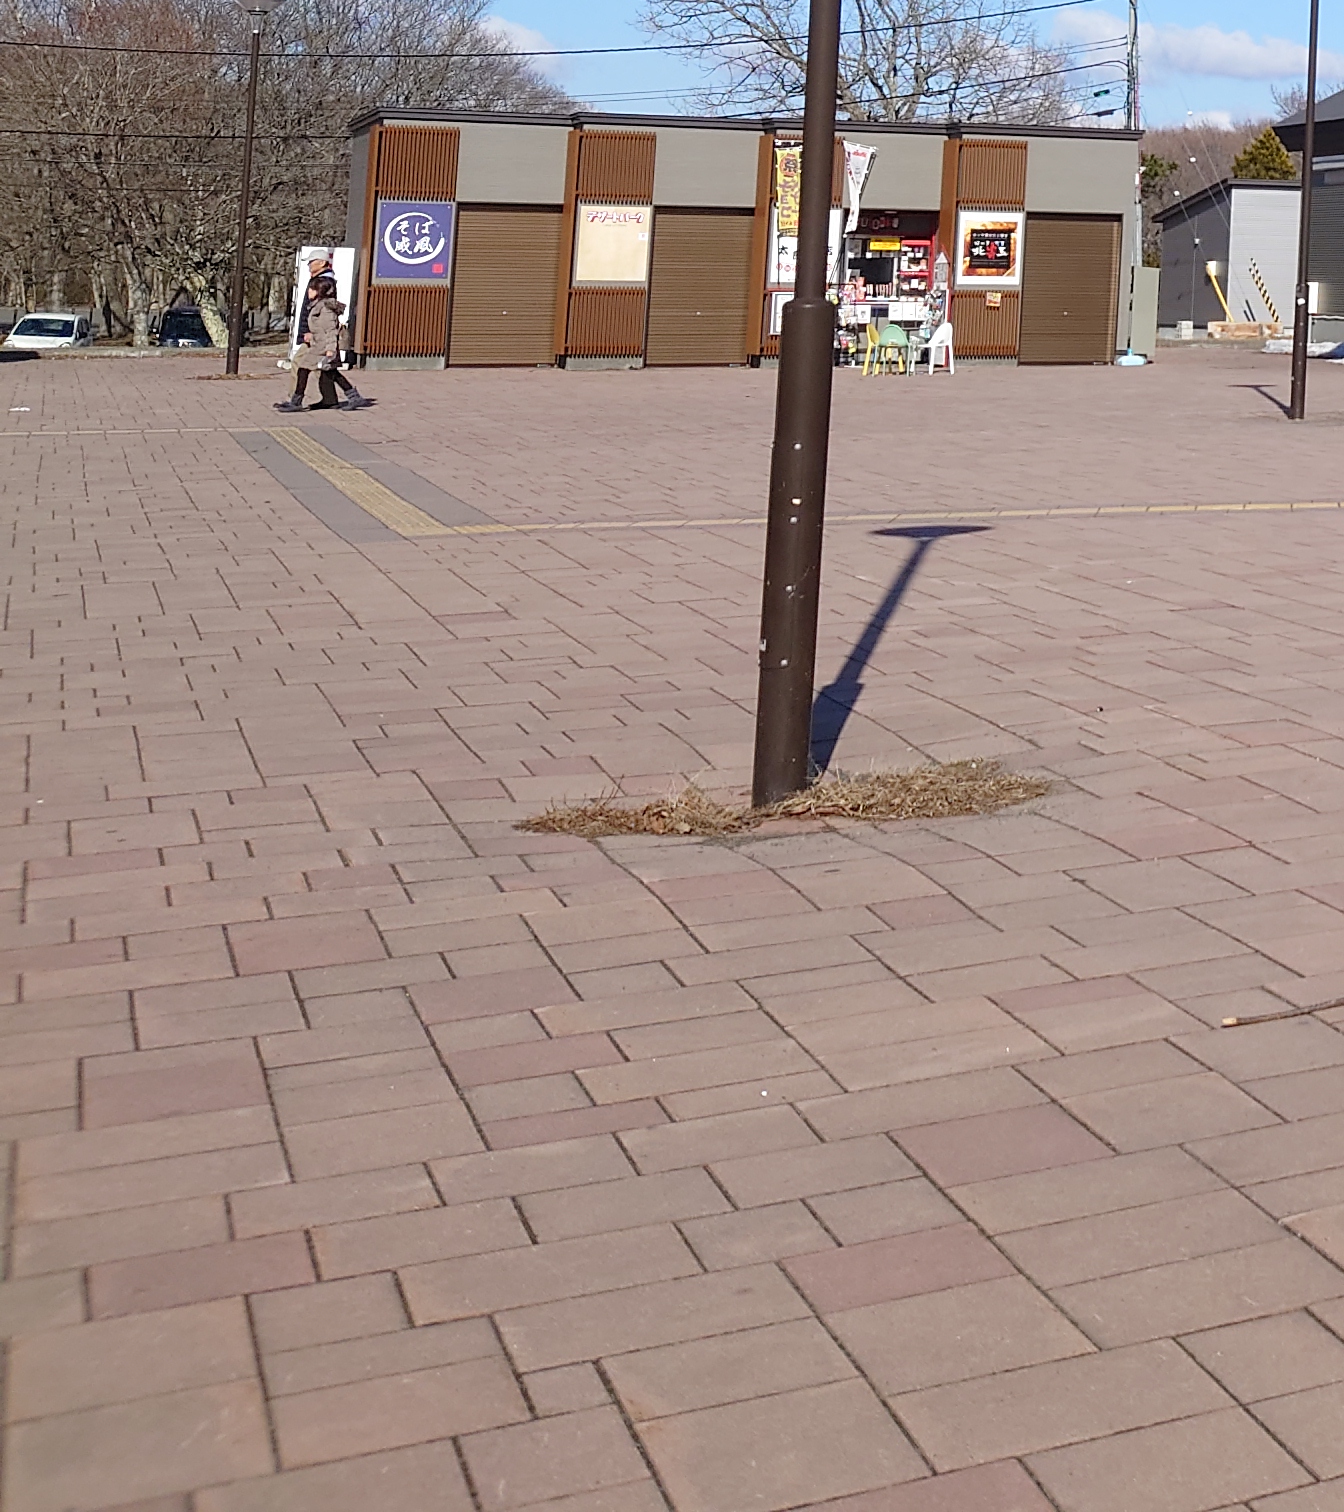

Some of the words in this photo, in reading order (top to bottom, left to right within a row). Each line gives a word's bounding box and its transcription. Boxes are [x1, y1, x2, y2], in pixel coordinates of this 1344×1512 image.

[586, 210, 645, 224] デザートパーク
[396, 220, 434, 236] そば
